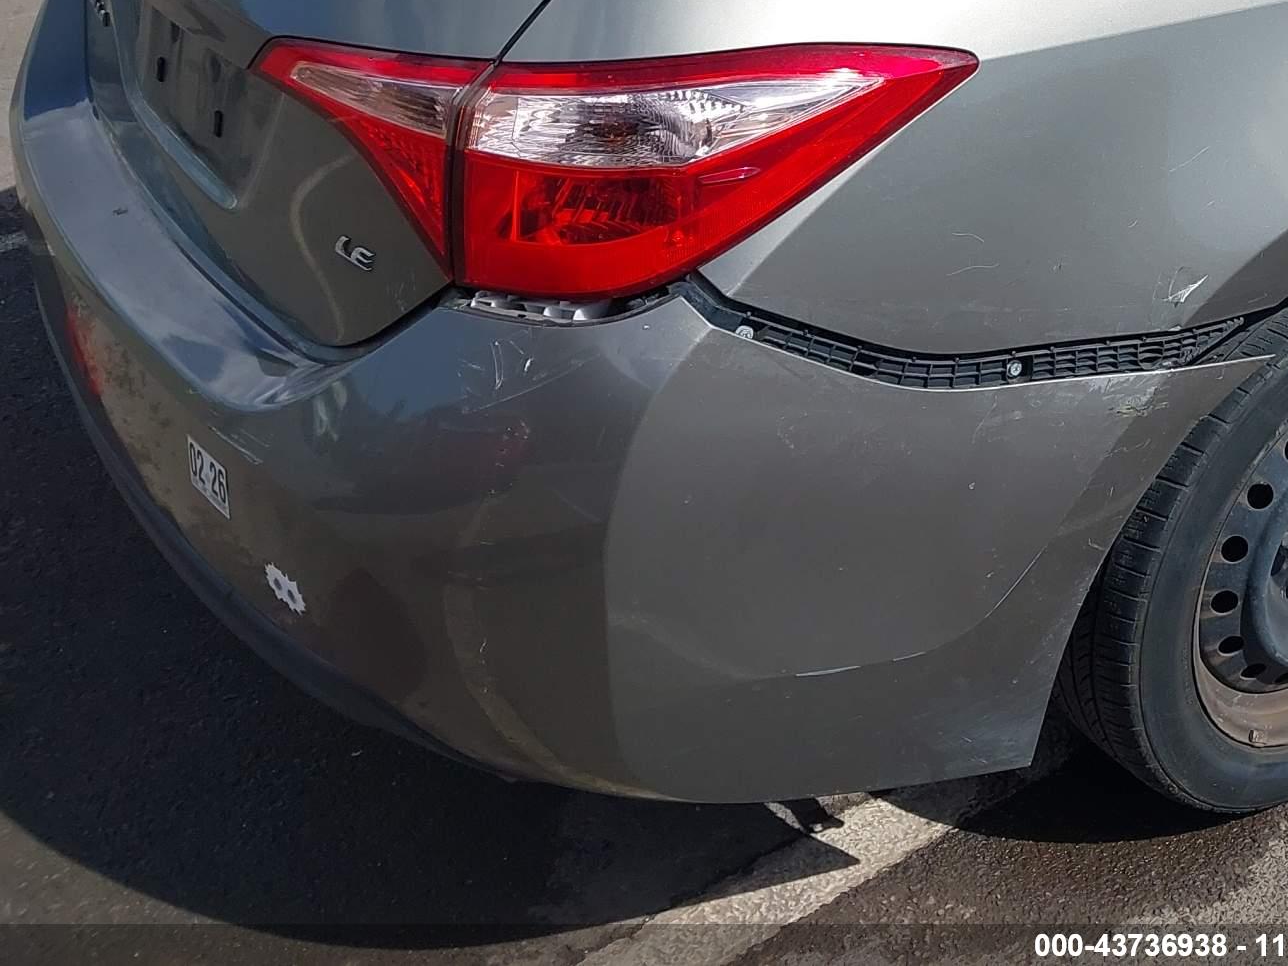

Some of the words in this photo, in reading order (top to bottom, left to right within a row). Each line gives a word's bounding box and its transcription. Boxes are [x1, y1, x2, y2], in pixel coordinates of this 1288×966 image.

[335, 236, 375, 270] LE
[189, 443, 206, 484] 02
[209, 461, 227, 505] 26
